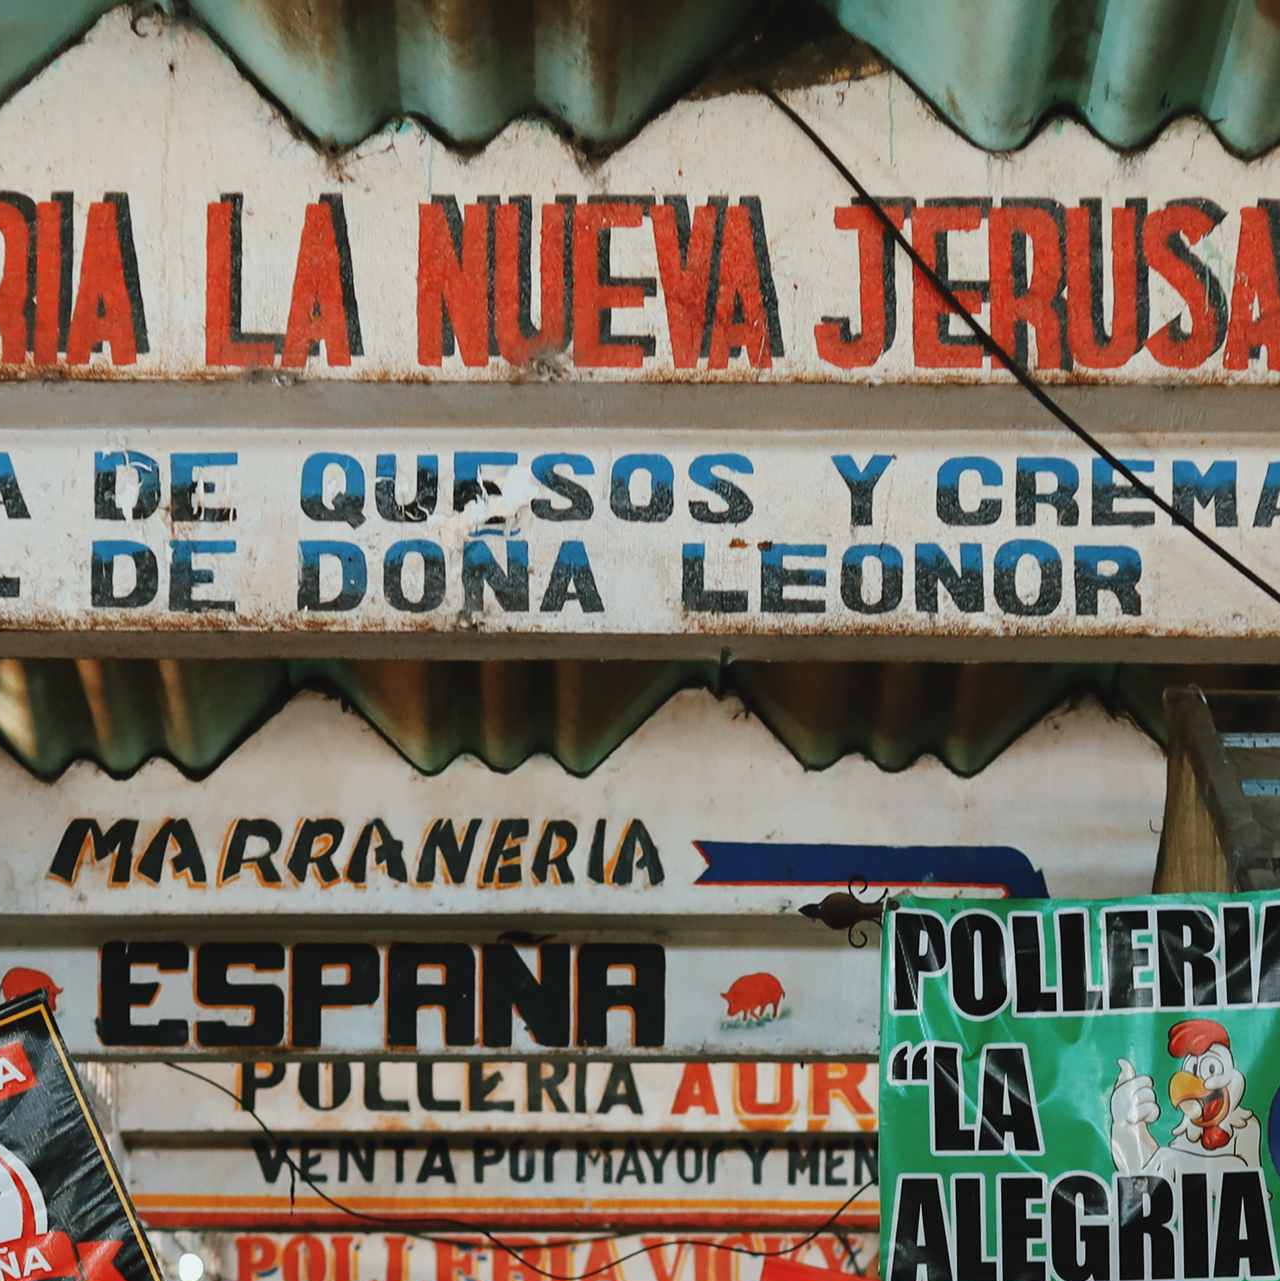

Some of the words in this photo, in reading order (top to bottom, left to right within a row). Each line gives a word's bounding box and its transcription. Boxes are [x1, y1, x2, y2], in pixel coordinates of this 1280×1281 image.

[205, 191, 363, 368] LA
[417, 193, 784, 369] NUEVA
[94, 450, 238, 522] DE
[300, 450, 754, 530] QUESOS
[831, 453, 897, 527] Y
[91, 539, 238, 612] DE
[296, 527, 605, 615] DOÑA
[681, 537, 1144, 616] LEONOR
[48, 815, 666, 890] MARRANERIA
[236, 1062, 644, 1115] POLLERIA
[250, 1138, 457, 1186] VENTA
[736, 1138, 769, 1185] Y
